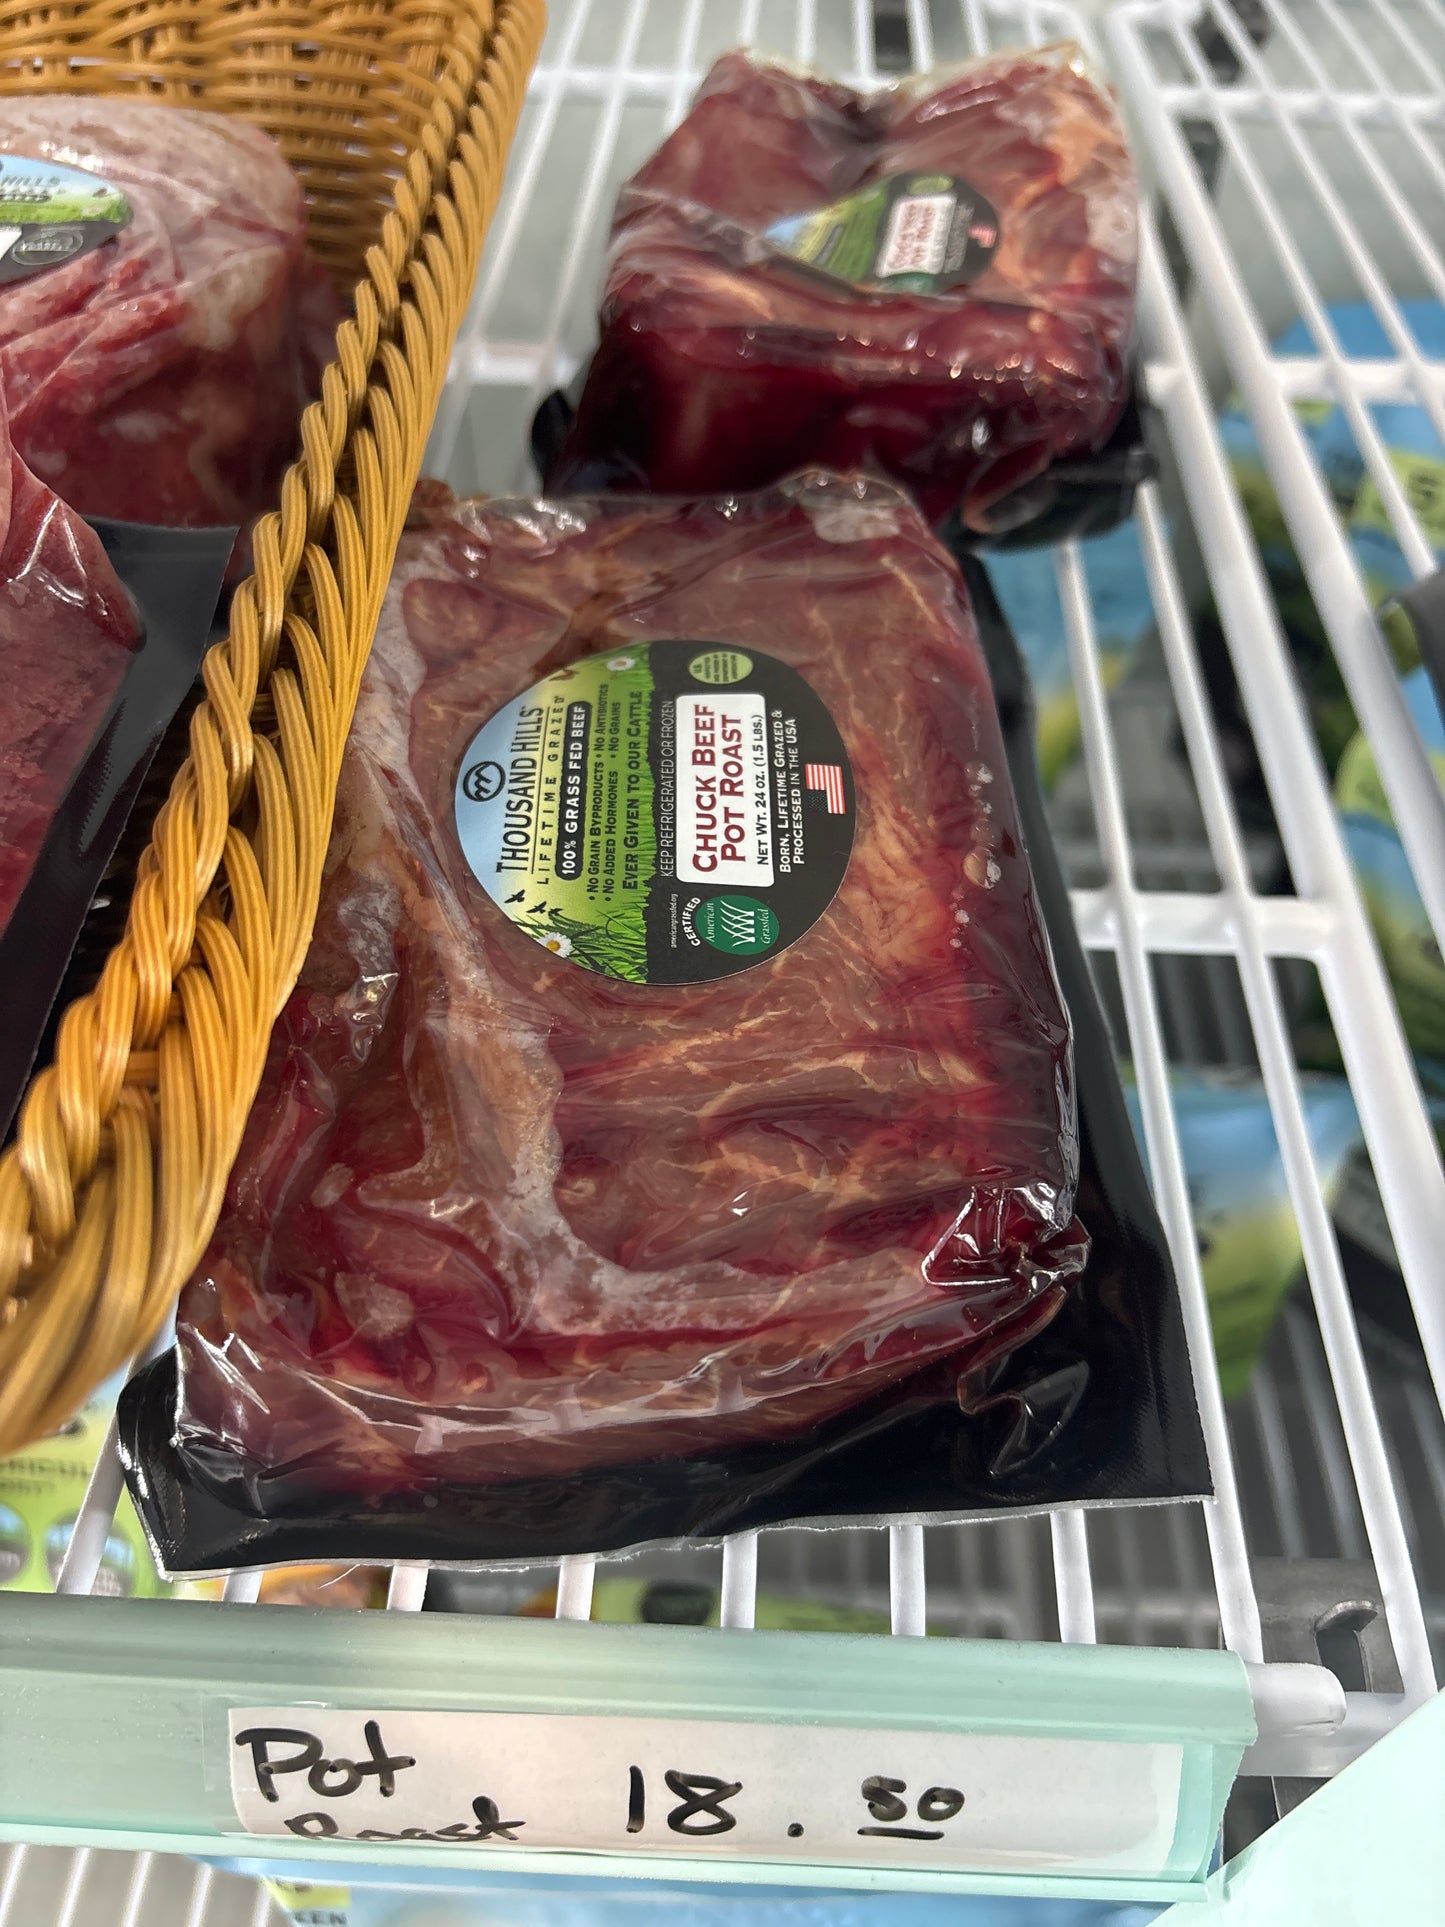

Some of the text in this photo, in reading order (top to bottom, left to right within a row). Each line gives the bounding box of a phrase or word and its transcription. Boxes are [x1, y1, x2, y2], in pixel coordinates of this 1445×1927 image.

[594, 684, 608, 751] NO ANTIBIOTICS
[609, 702, 620, 751] NO GRAINS
[496, 758, 537, 873] THOUSAND
[537, 777, 556, 884] LIFETIME
[562, 706, 585, 874] 100% GRASS FED BEEF
[587, 762, 604, 893] NO GRAIN BYPRODUCTS
[603, 771, 618, 894] NO ADDED HORMONES
[623, 691, 642, 889] EVER GIVEN TO OUR CATTLE
[661, 701, 674, 877] KEEP REFRIGERATED OR FROZEN
[692, 705, 717, 872] CHUCK BEEF
[720, 714, 746, 862] POT ROAST
[752, 714, 768, 865] NET WT. 24 OZ. (1.5 LBS.)
[771, 709, 791, 872] BORN, LIFETIME GRAZED &
[786, 719, 804, 864] PROCESSED IN THE USA
[670, 894, 678, 948] americangrassfed.org
[682, 897, 701, 946] CERTIFIED
[704, 903, 715, 942] American
[758, 909, 771, 944] Grassfed
[235, 1720, 416, 1803] Pot
